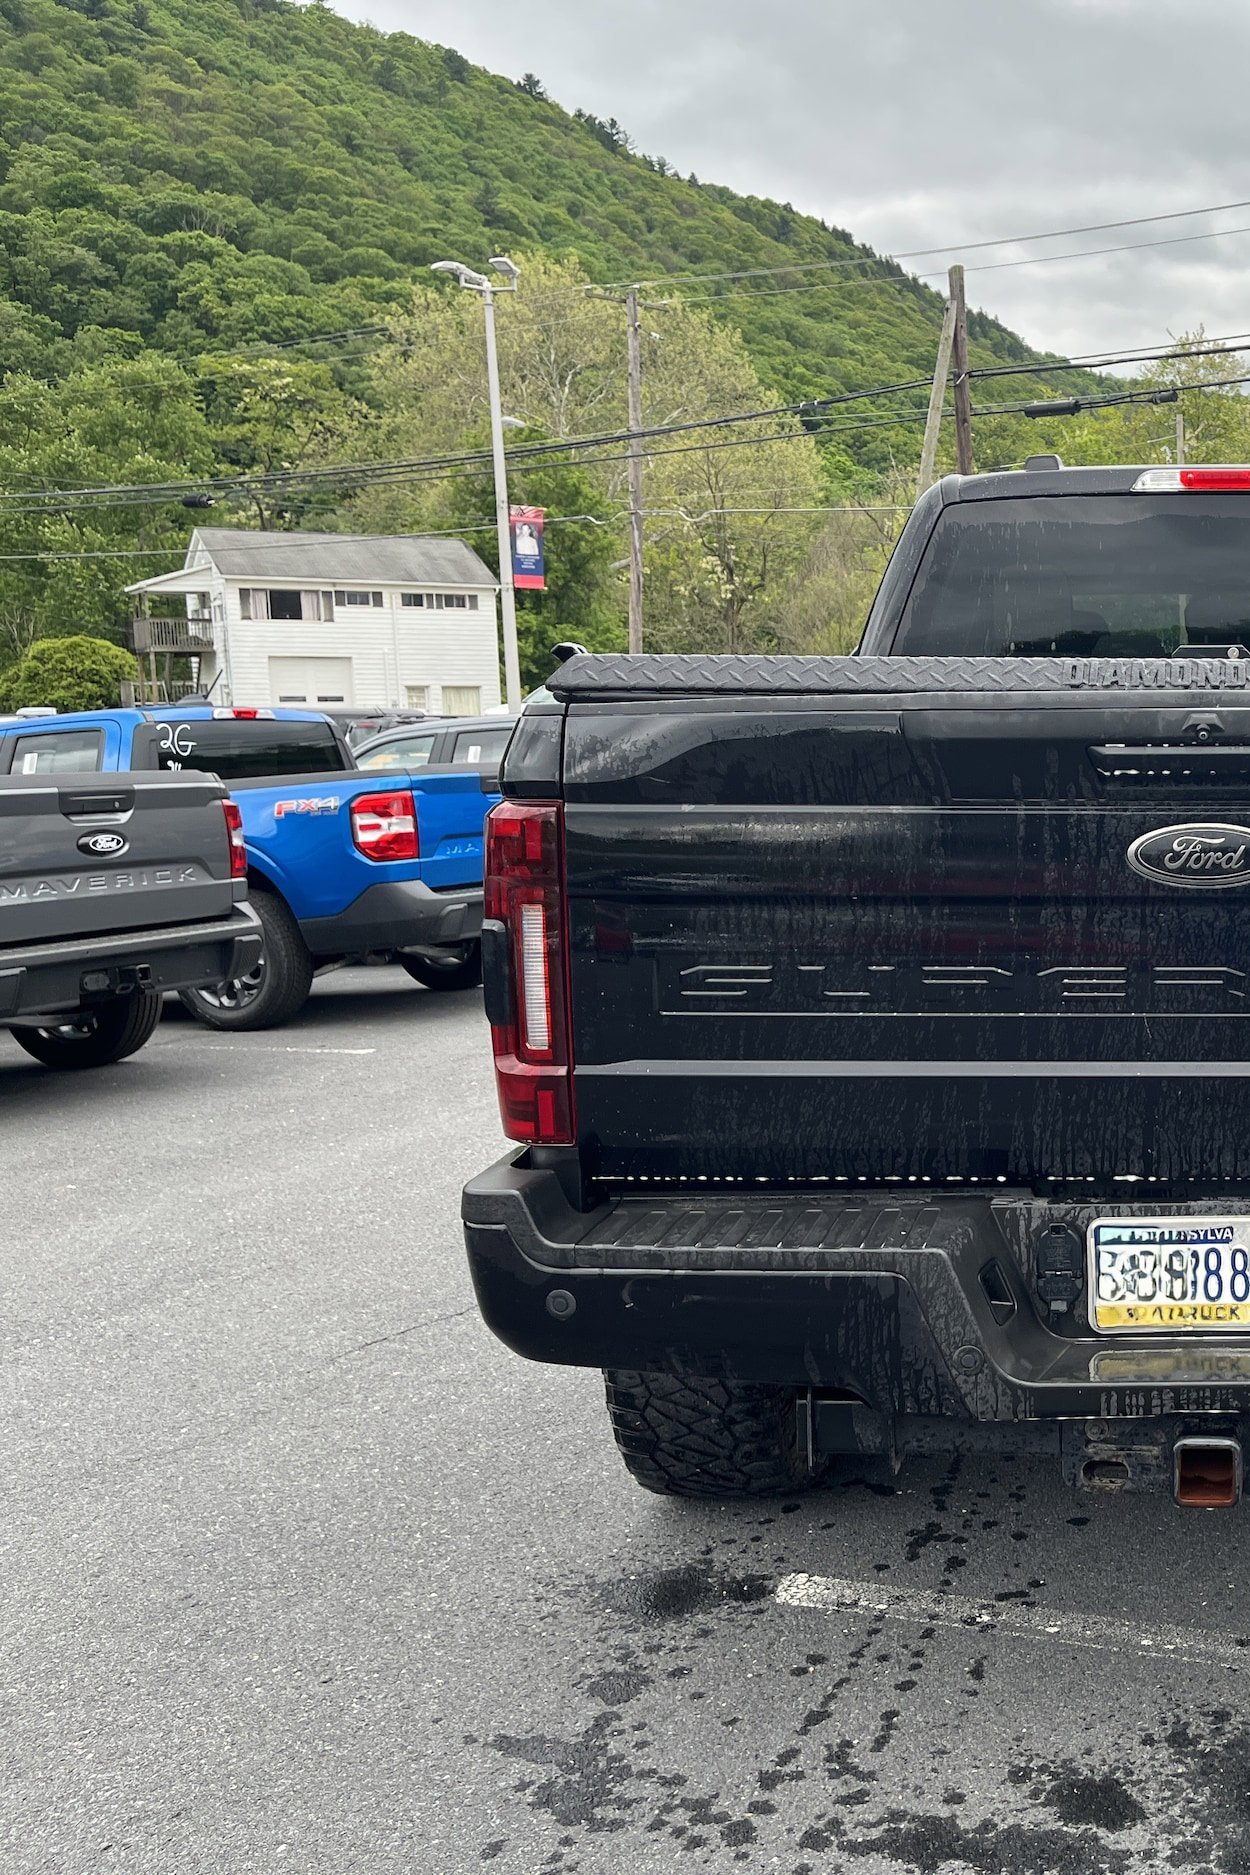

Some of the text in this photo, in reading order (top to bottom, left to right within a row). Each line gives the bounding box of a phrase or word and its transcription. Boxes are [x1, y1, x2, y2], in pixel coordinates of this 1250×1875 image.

[274, 796, 340, 818] FX4
[1163, 835, 1247, 871] Ford
[0, 867, 198, 900] MAVERICK
[680, 964, 1246, 1001] SUPER
